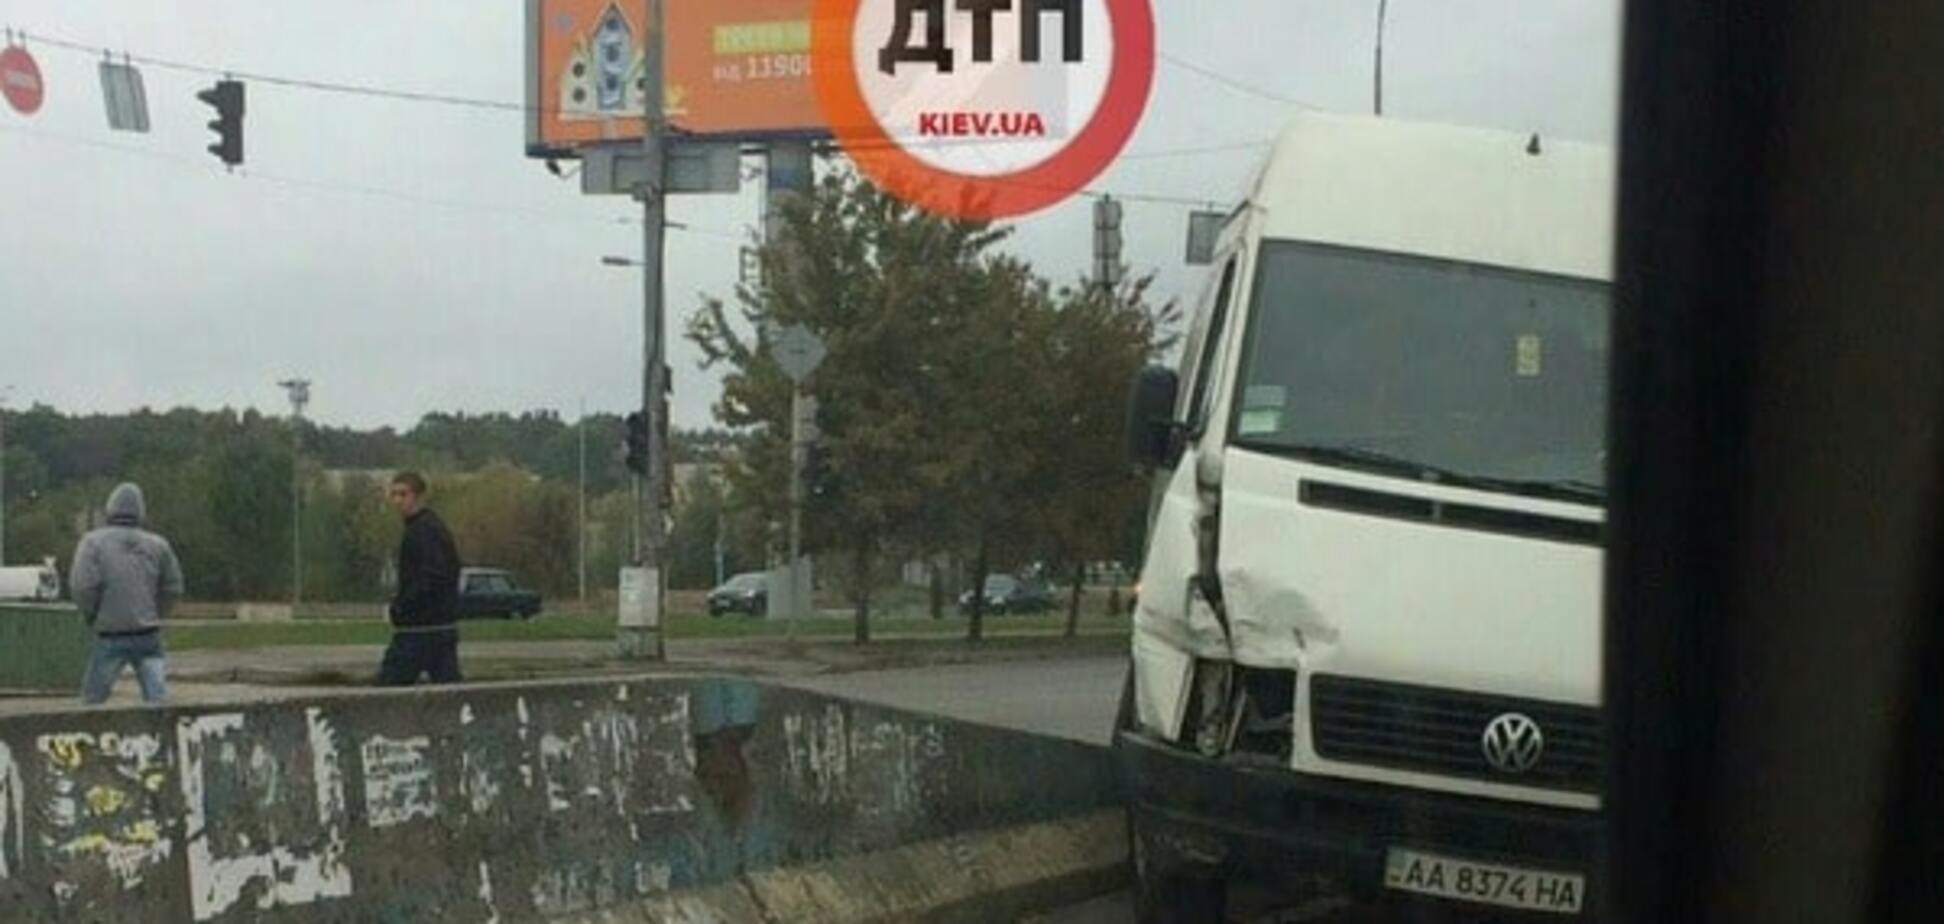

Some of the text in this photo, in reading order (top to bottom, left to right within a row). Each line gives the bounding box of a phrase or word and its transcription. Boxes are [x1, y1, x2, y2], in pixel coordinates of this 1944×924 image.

[1406, 858, 1445, 889] AA
[1456, 866, 1525, 903] 8374
[1535, 876, 1576, 908] HA
